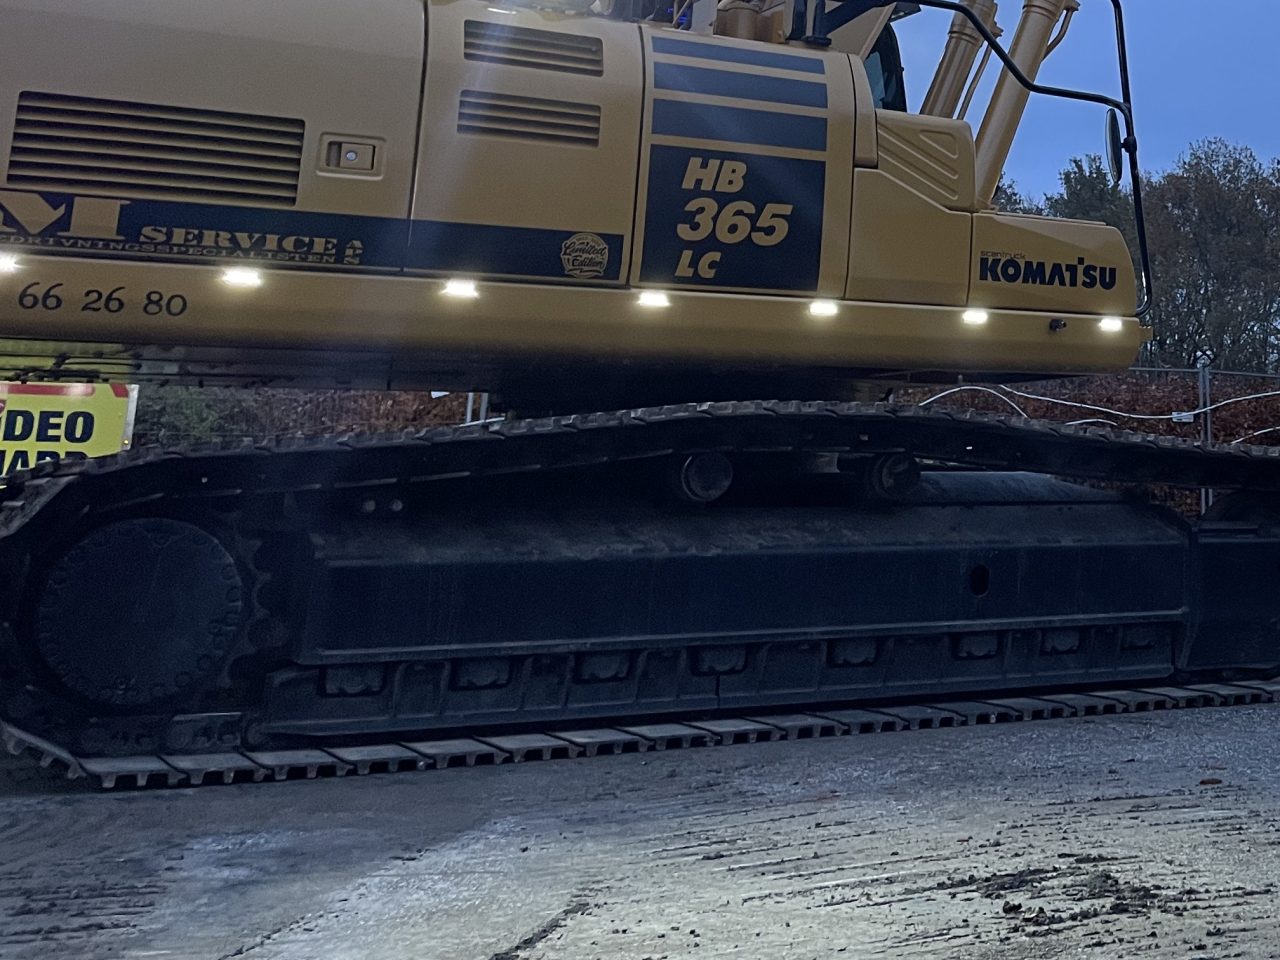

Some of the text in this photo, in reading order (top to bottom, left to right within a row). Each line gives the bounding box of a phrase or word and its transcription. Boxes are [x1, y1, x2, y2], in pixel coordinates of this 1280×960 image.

[681, 156, 747, 193] HB
[676, 197, 794, 247] 365
[139, 225, 338, 255] SERVICE
[562, 240, 608, 257] Limited
[571, 254, 604, 269] Edition
[674, 249, 722, 279] LC
[979, 256, 1117, 290] KOMATSU
[17, 282, 188, 317] 66 26 80
[0, 409, 95, 443] DEO
